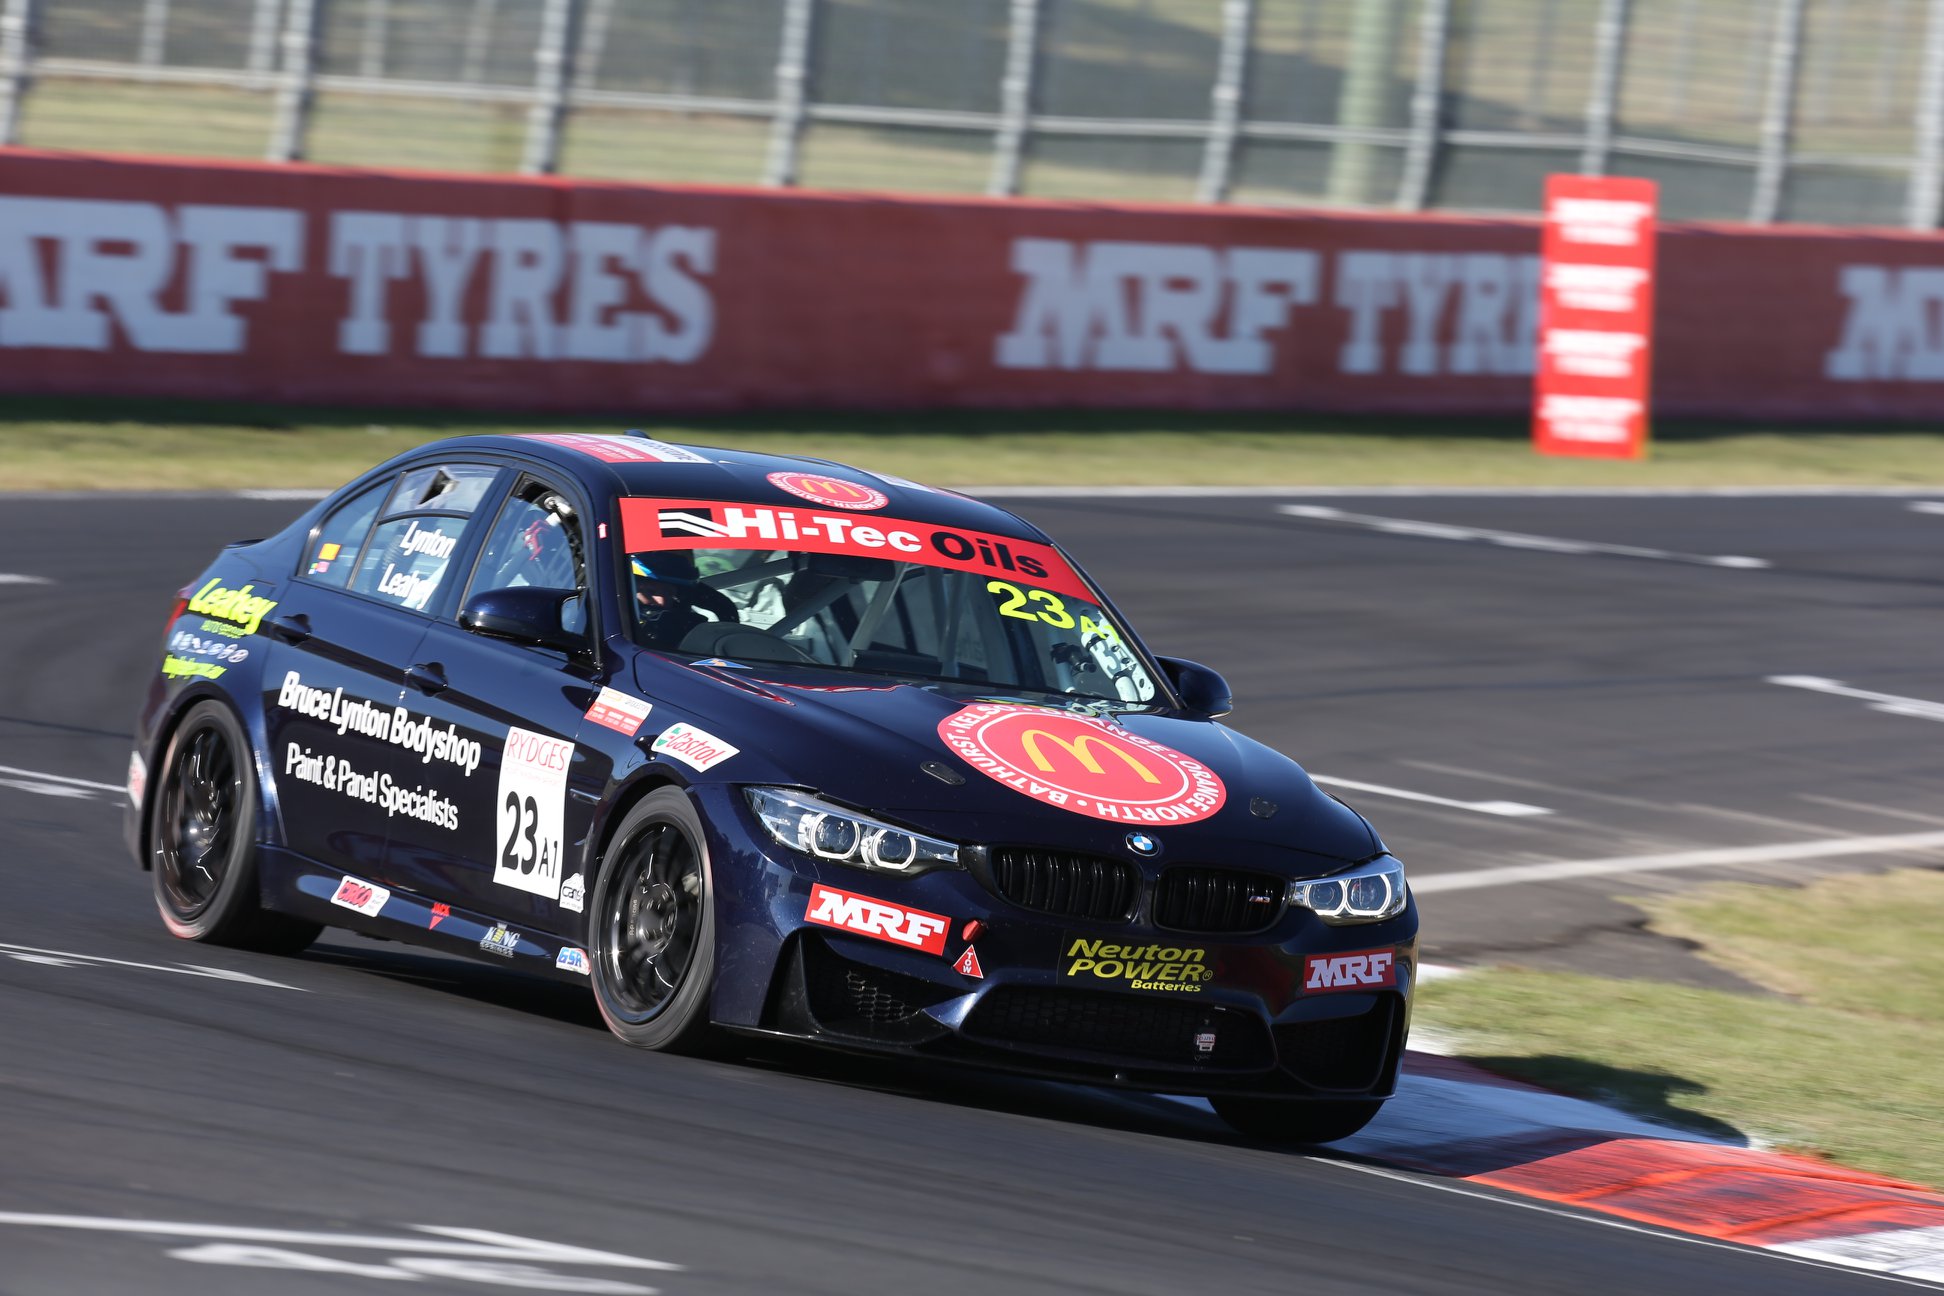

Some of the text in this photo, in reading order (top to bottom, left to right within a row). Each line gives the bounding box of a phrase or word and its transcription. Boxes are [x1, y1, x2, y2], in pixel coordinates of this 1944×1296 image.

[328, 211, 718, 364] TYRES
[997, 239, 1319, 374] MRF
[1822, 264, 1944, 382] M
[399, 520, 457, 559] Lynton
[723, 507, 1049, 579] Hi-Tec Oils
[377, 562, 440, 610] Leahey
[278, 671, 331, 720] Bruce
[329, 687, 390, 735] Lynton
[389, 707, 481, 777] Bodyshop
[507, 731, 569, 771] RYDGES
[665, 732, 726, 765] Castrol
[285, 742, 324, 785] Paint
[323, 755, 337, 790] &
[337, 759, 379, 804] Panel
[379, 773, 459, 830] Specialists
[945, 731, 1071, 807] BATHURST
[812, 889, 945, 950] MRF
[962, 951, 974, 974] TOW
[1067, 938, 1206, 962] Neuton
[1305, 952, 1393, 990] MRF
[1130, 979, 1201, 992] Batteries
